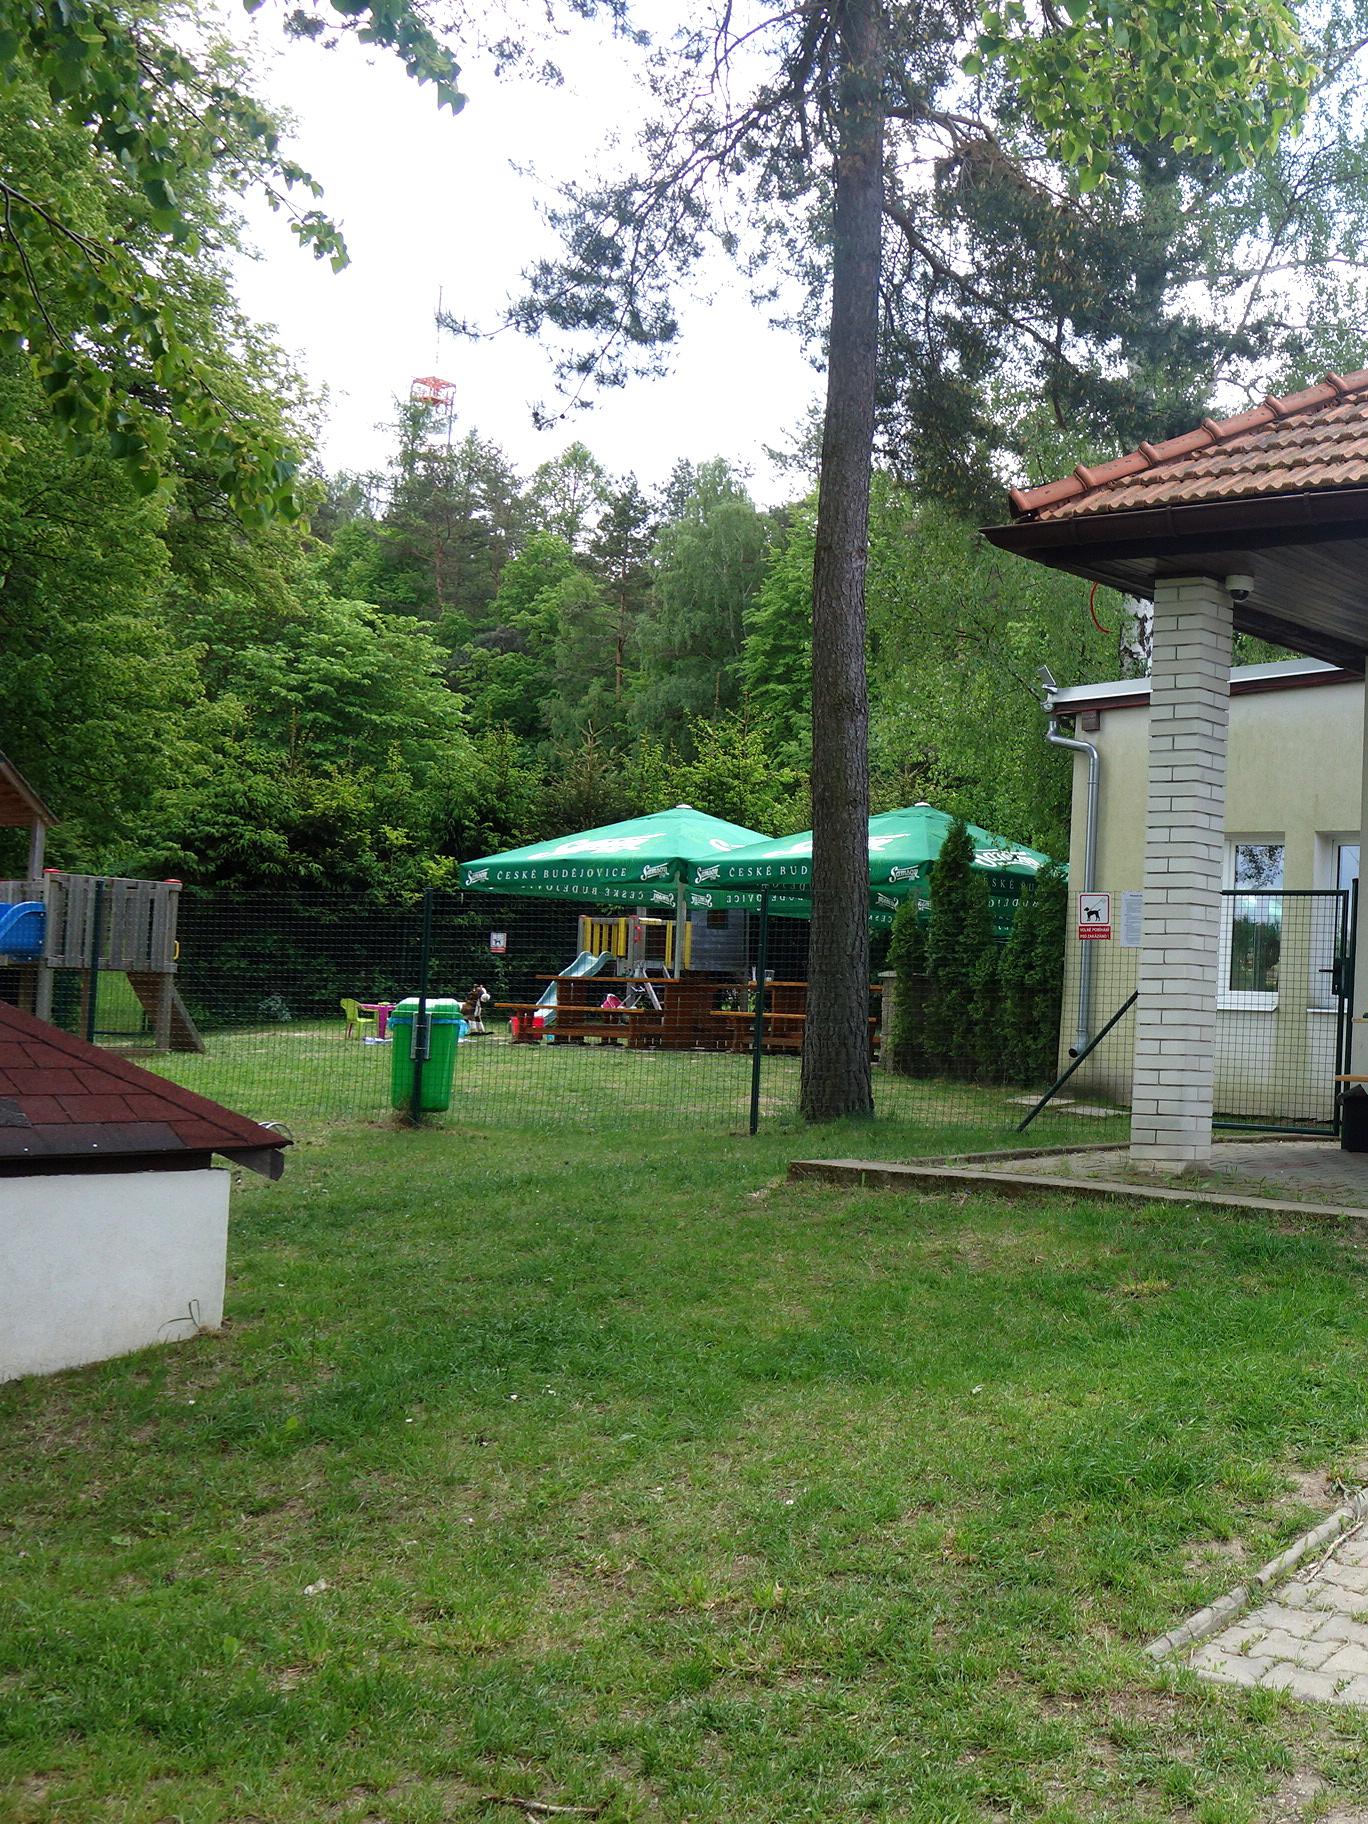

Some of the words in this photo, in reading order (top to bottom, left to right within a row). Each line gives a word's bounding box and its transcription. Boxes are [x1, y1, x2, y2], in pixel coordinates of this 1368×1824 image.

[497, 868, 537, 881] ČESKÉ
[543, 867, 628, 879] BUDĚJOVICE
[729, 866, 772, 878] ČESKÉ
